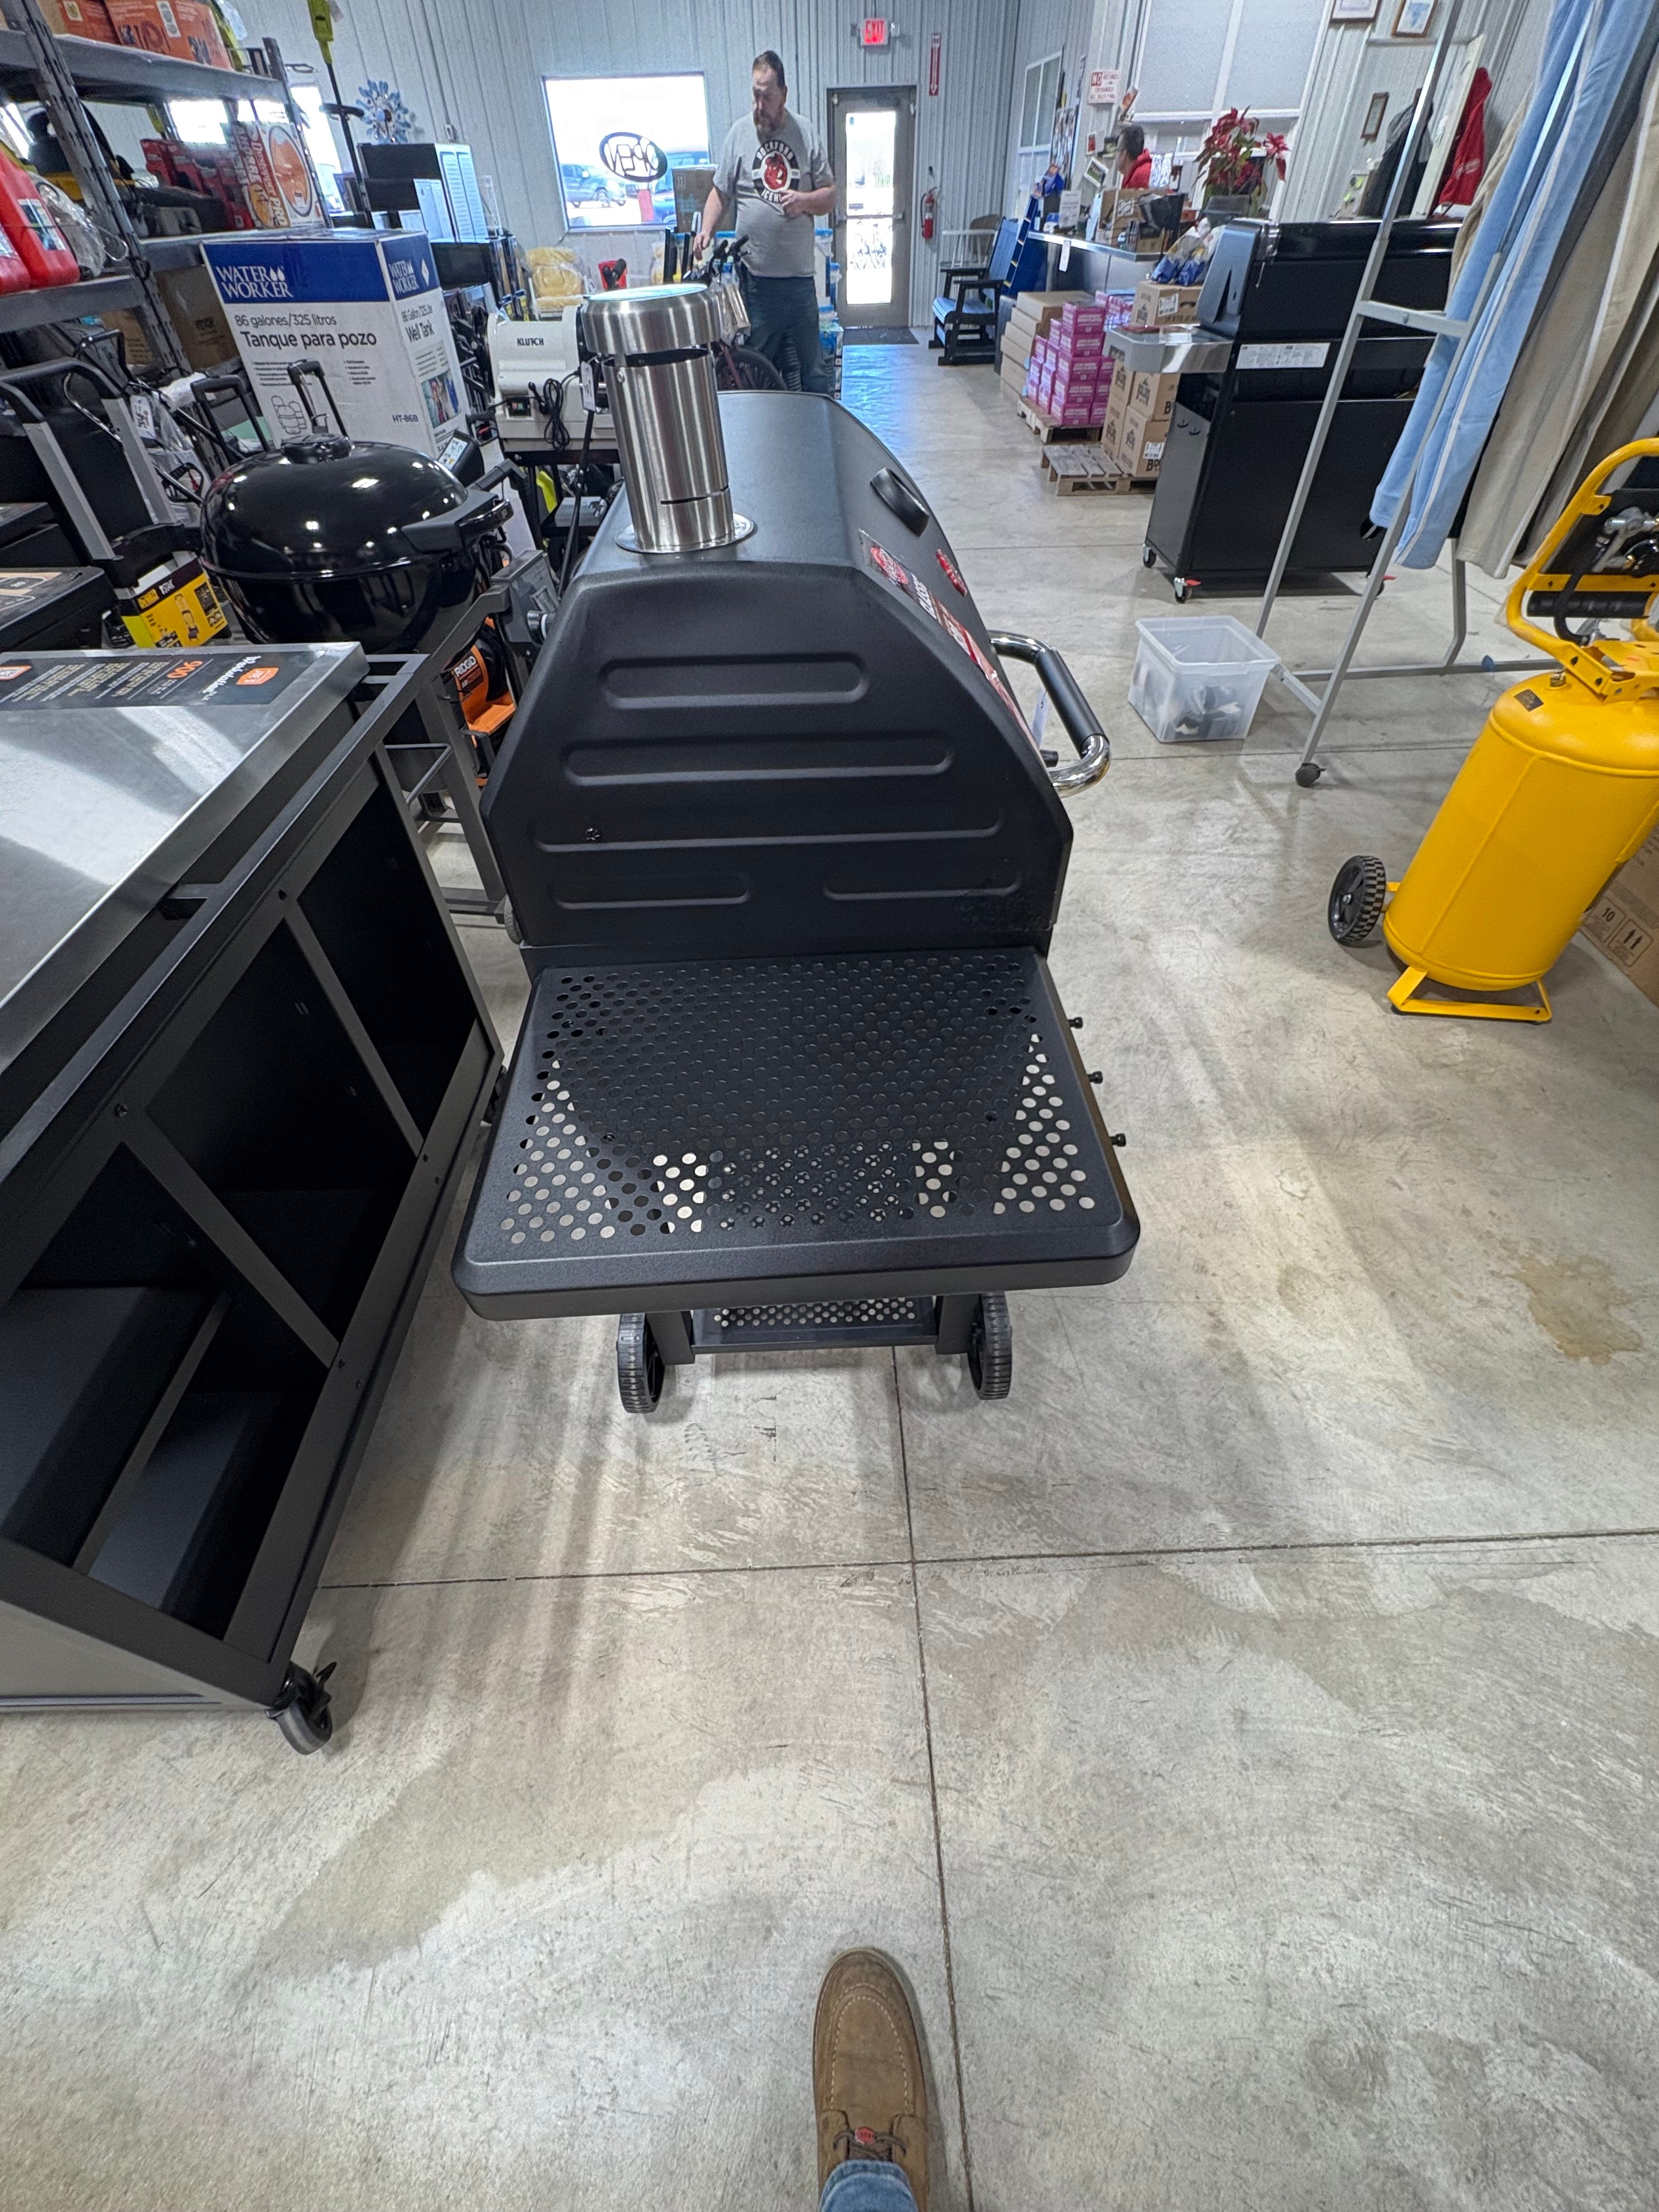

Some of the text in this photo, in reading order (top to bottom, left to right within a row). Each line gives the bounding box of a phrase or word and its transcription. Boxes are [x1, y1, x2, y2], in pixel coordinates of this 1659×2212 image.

[865, 20, 885, 44] EXIT
[1091, 72, 1103, 86] NO
[216, 266, 271, 283] WATER
[221, 281, 294, 298] WORKER
[392, 274, 420, 294] WORKER
[235, 313, 337, 329] 86 galones/325 litros
[405, 319, 435, 343] Well Tank
[240, 331, 377, 350] Tanque para pozo
[517, 337, 544, 347] KLUTCH
[392, 414, 419, 423] HT-86B
[1602, 907, 1616, 923] 10
